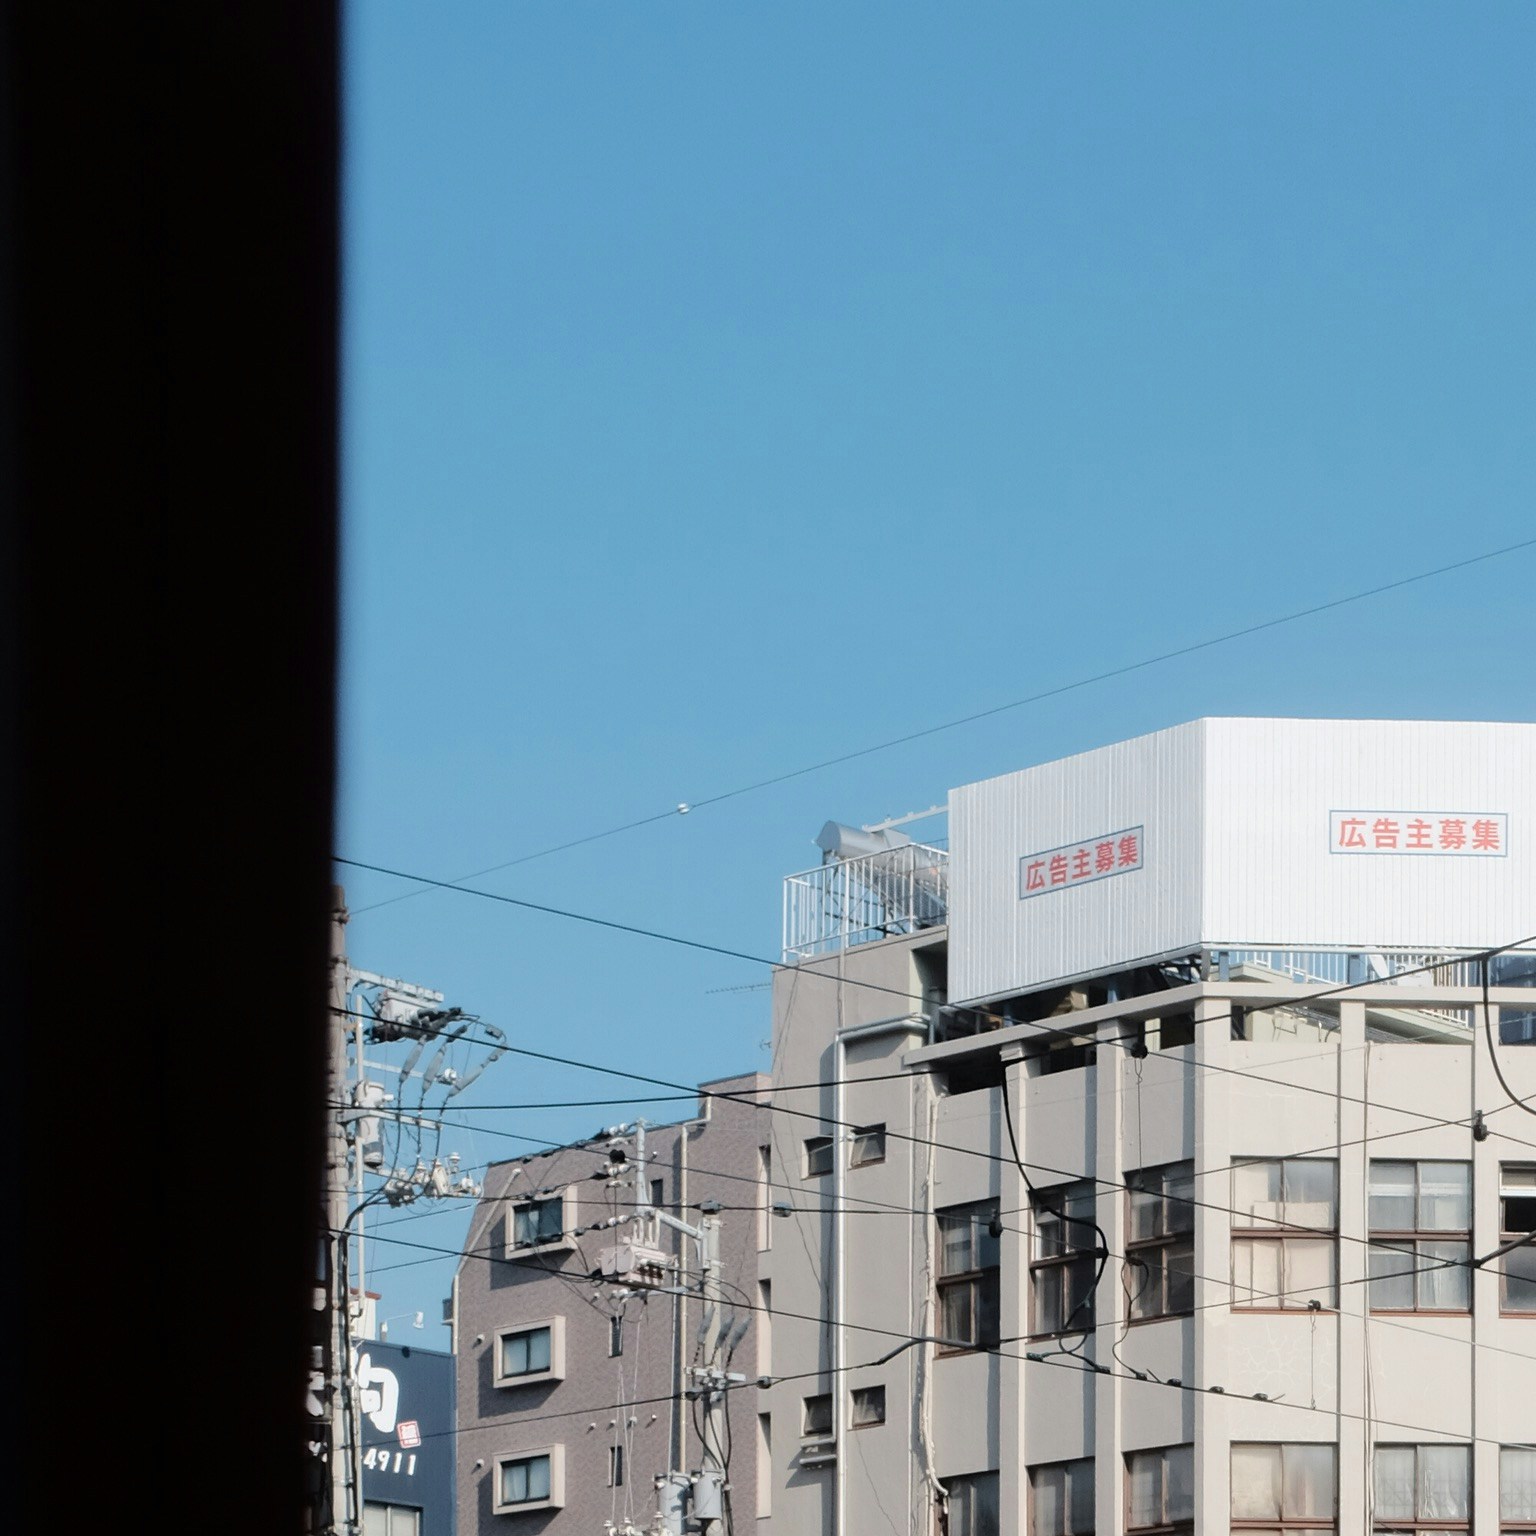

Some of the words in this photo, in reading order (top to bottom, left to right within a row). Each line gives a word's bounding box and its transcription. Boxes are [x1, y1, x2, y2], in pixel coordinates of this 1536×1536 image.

[1338, 818, 1500, 850] 広告主募集
[1025, 834, 1138, 891] 広告主募集
